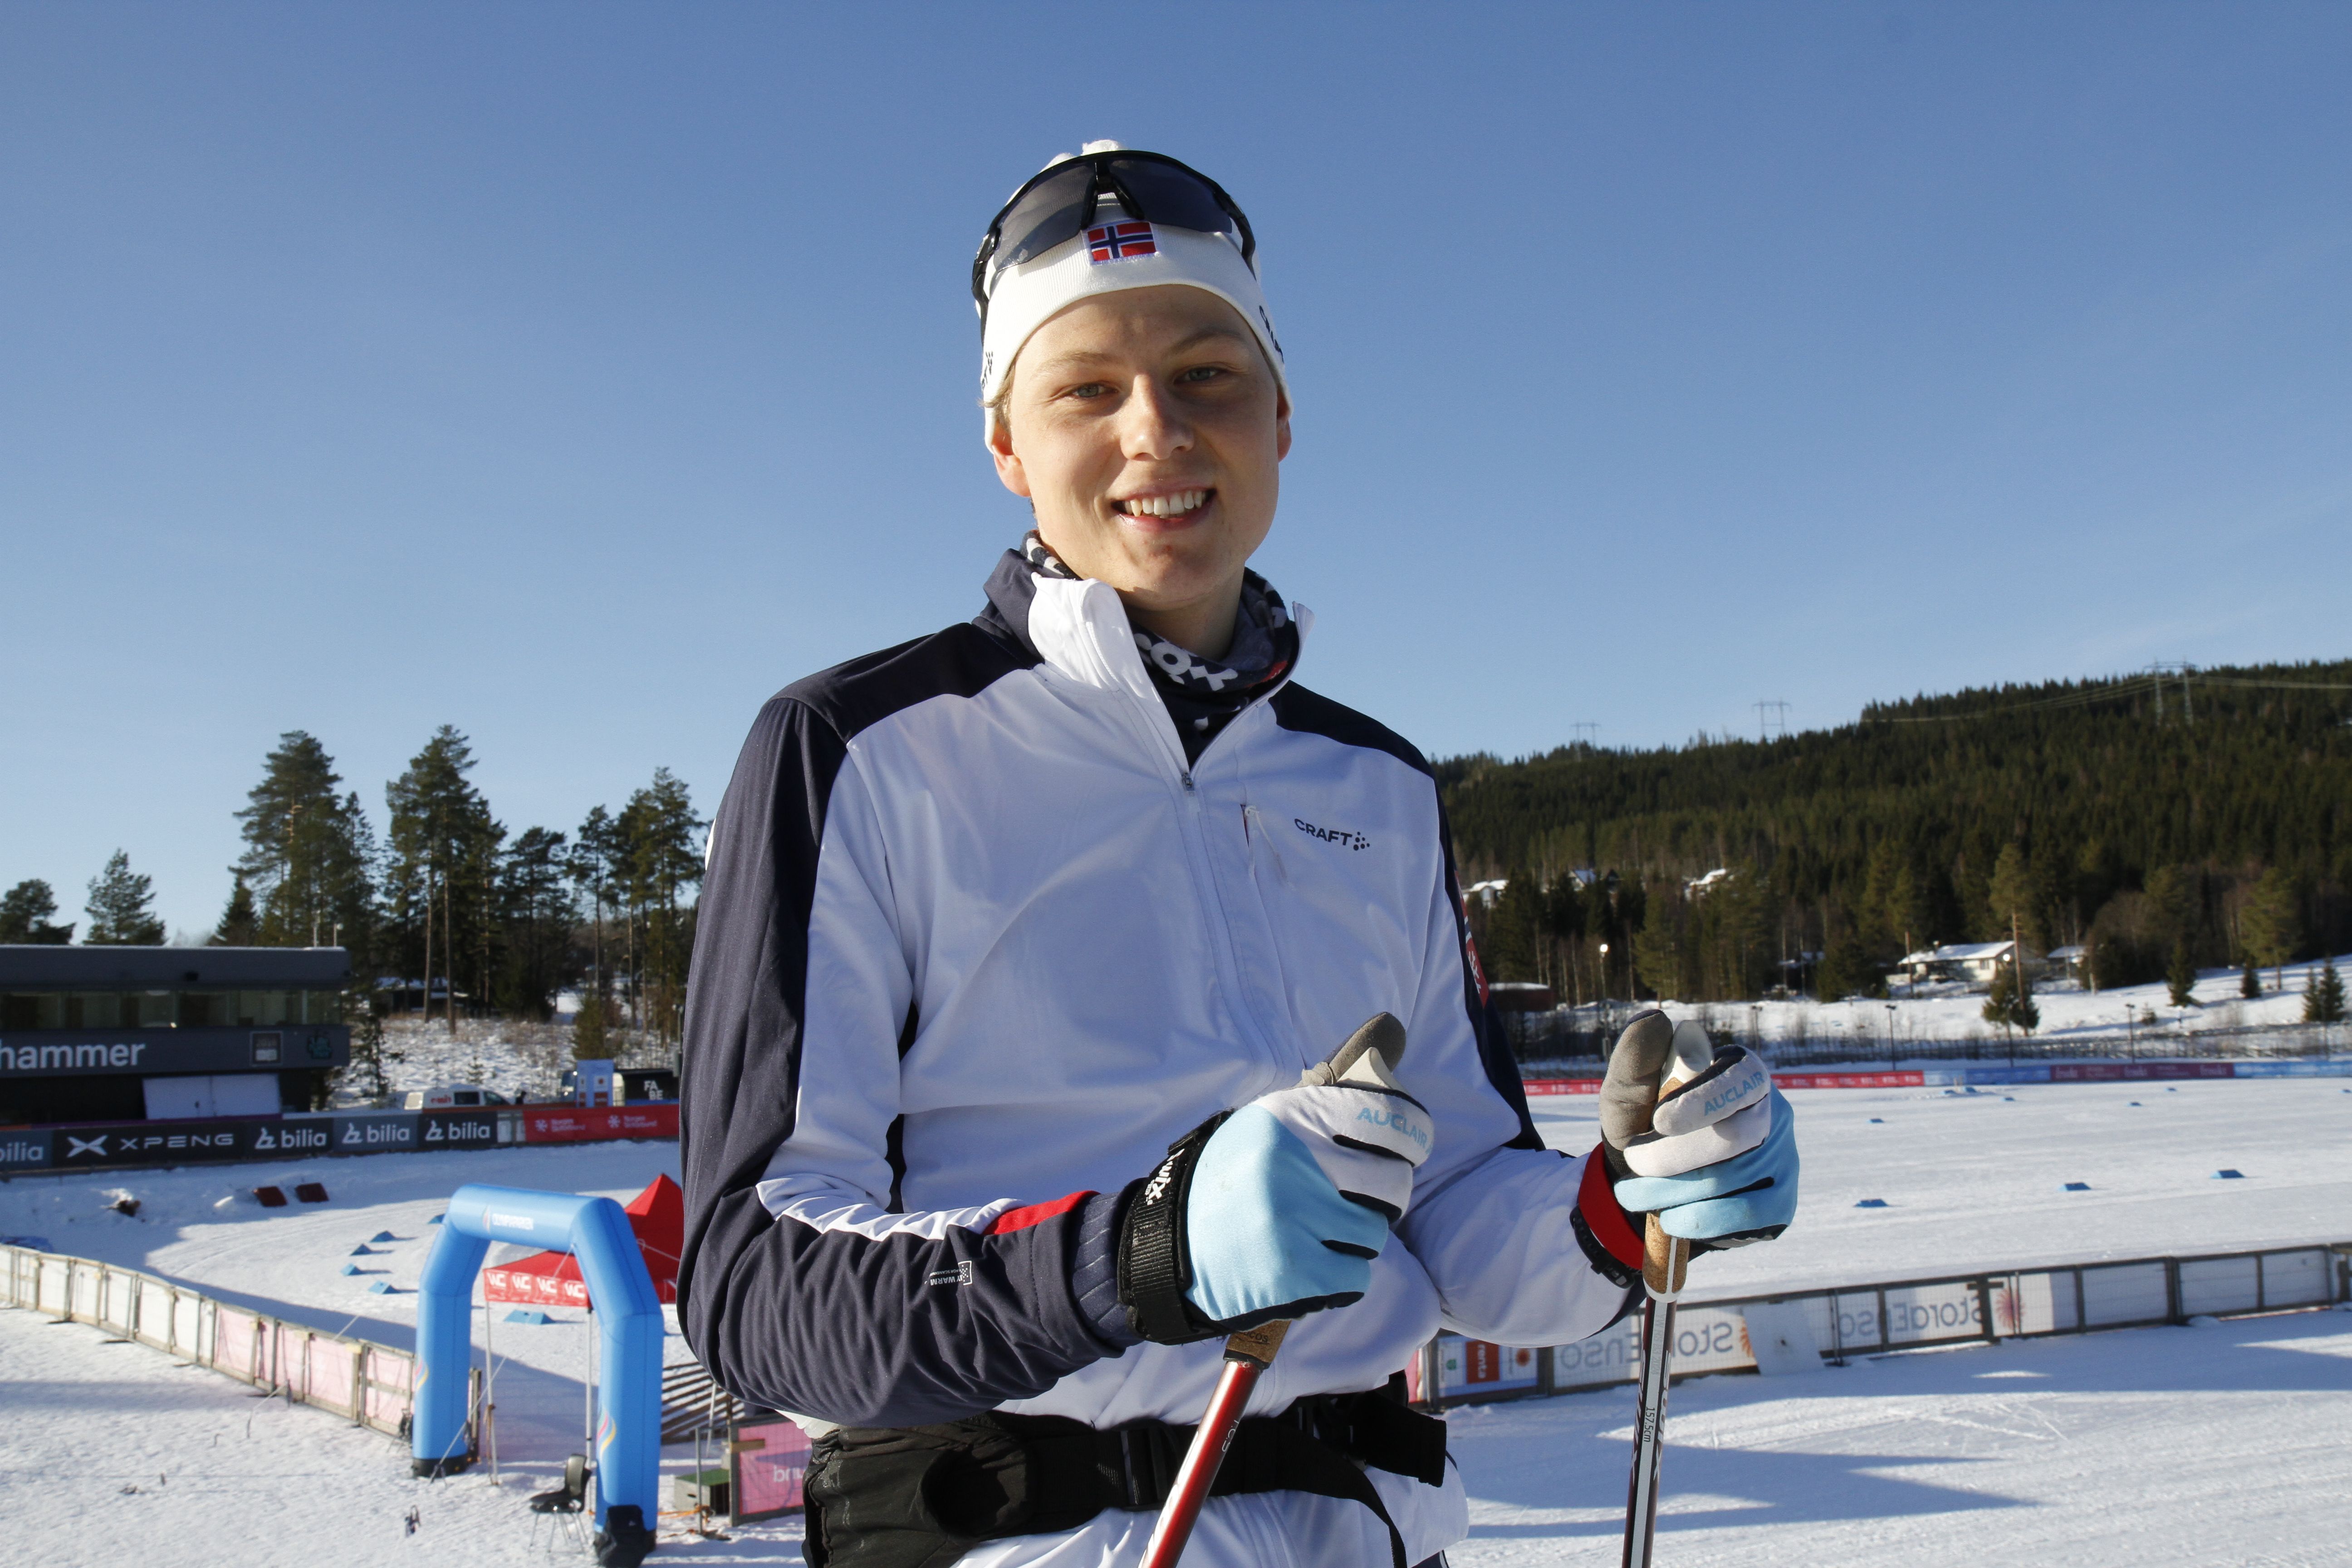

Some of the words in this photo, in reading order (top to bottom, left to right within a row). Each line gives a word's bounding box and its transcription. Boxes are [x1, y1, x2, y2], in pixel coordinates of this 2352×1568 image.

[1294, 818, 1352, 845] CRAFT
[0, 1038, 146, 1070] hammer
[1704, 1071, 1764, 1116] AUCLAIR
[120, 1134, 233, 1150] XPENG
[281, 1128, 327, 1148] bilia
[366, 1124, 410, 1143] bilia
[449, 1123, 490, 1141] bilia
[1355, 1107, 1428, 1148] AUCLAIR
[1477, 1343, 1489, 1379] renta
[1643, 1406, 1656, 1443] 157.5cm
